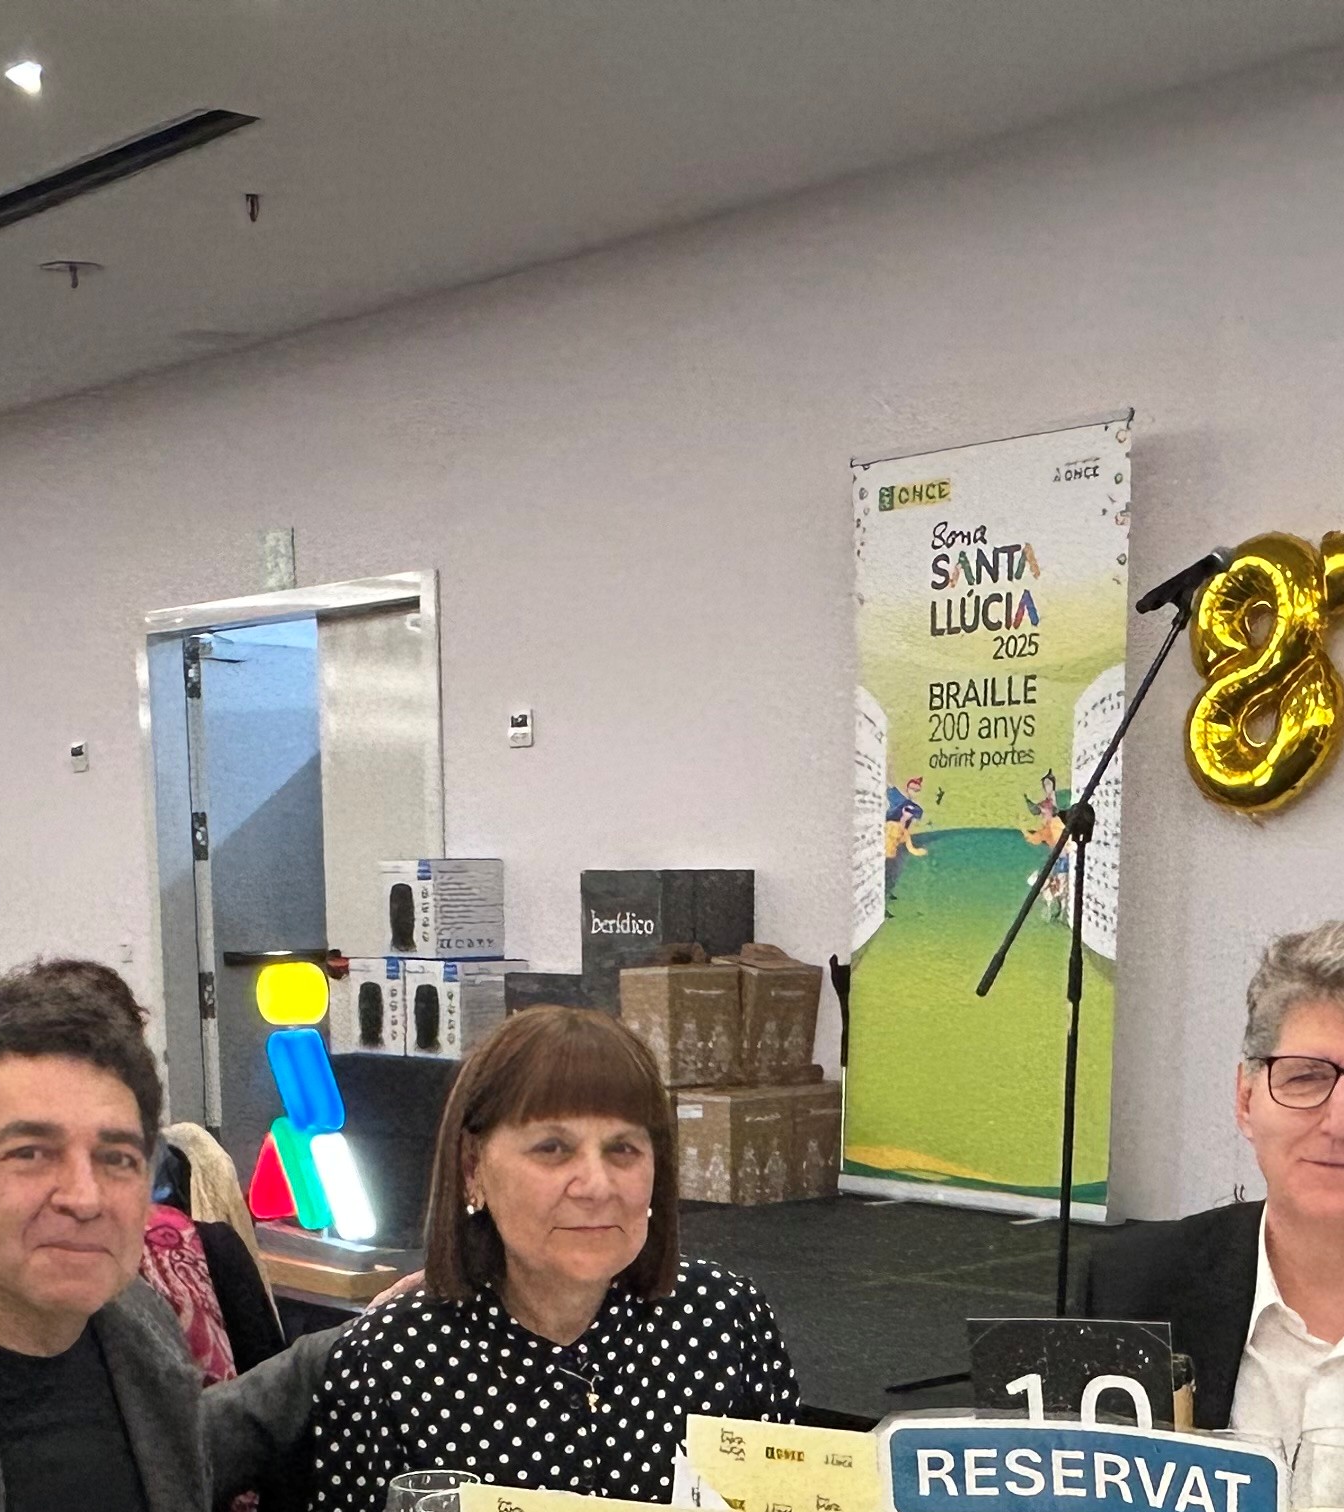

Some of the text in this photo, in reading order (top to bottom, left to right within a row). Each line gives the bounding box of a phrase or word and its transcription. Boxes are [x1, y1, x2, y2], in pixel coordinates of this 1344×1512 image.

[898, 481, 950, 505] ONCE
[931, 543, 1041, 590] SANTA
[930, 589, 1040, 637] LLÚCIA
[992, 633, 1040, 661] 2025
[929, 674, 1037, 711] BRAILLE
[929, 711, 1035, 745] 200 anys
[929, 747, 1035, 770] obrint portes
